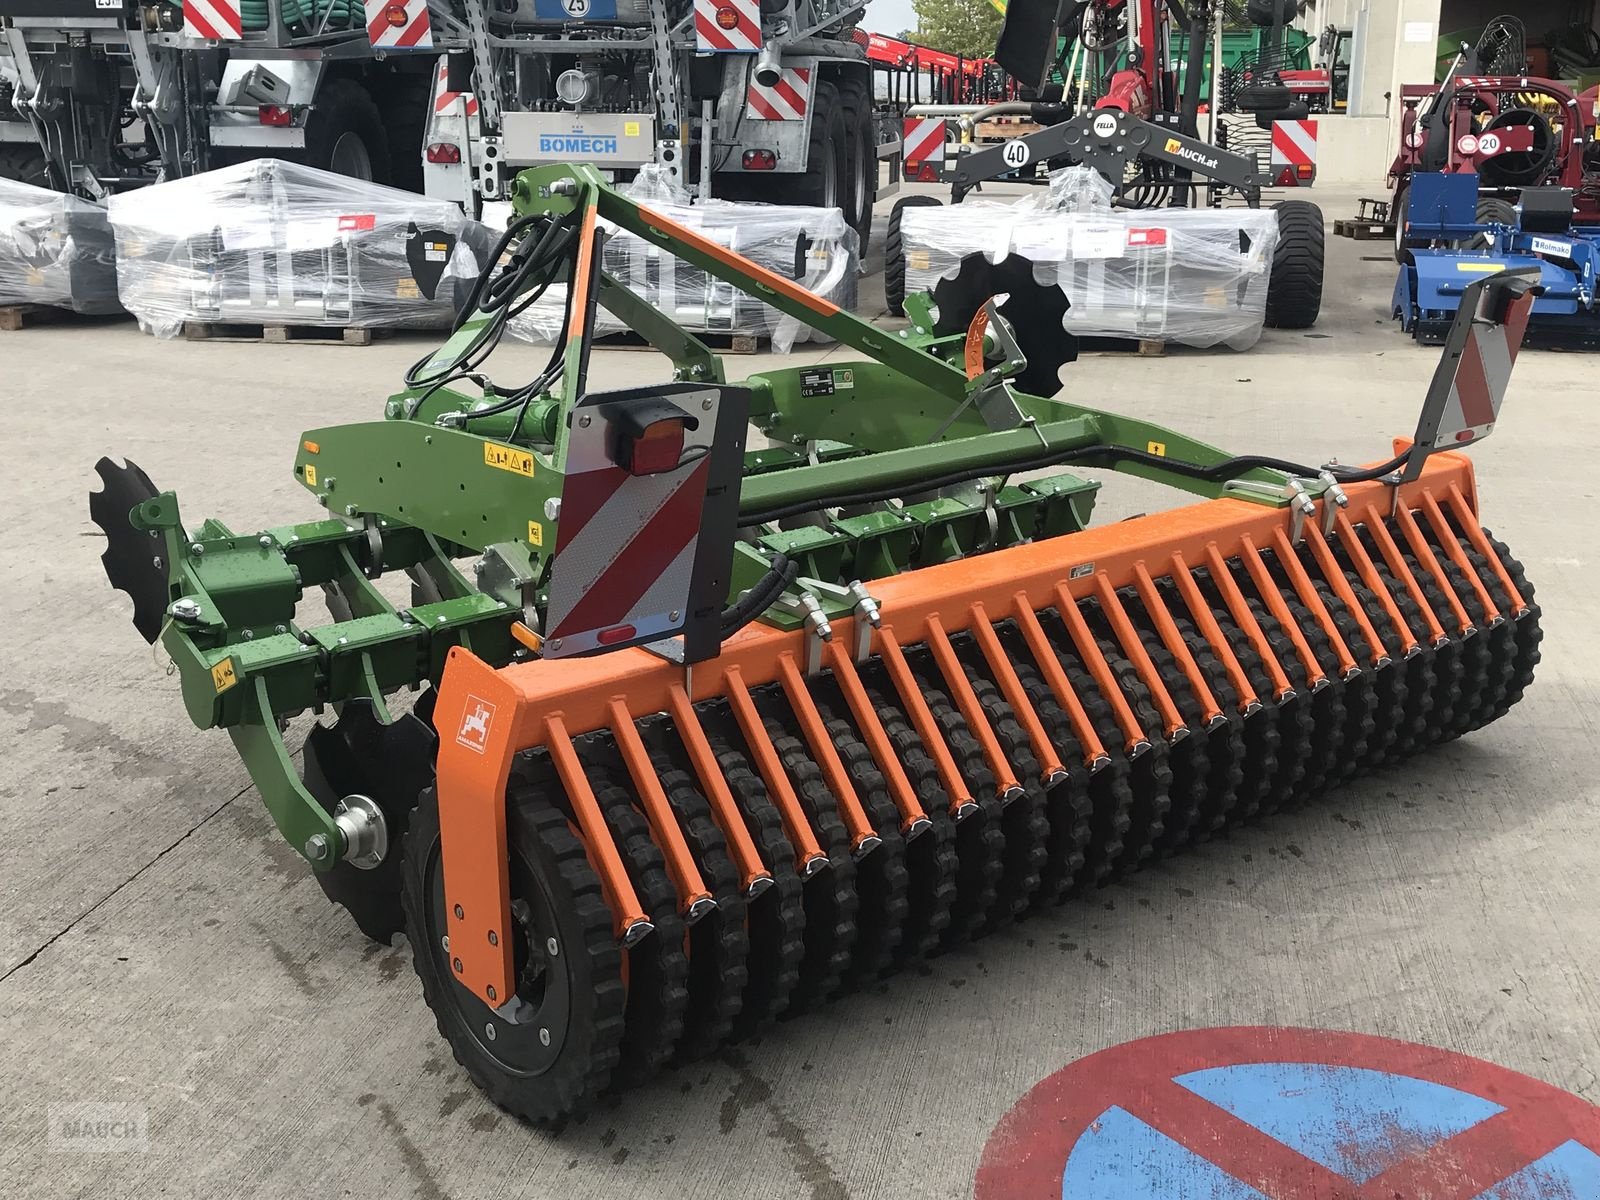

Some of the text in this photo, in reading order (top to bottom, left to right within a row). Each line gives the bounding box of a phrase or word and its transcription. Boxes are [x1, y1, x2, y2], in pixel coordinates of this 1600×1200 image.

[540, 138, 616, 153] BOMECH
[1481, 138, 1497, 150] 20
[1007, 145, 1025, 163] 40
[1168, 144, 1218, 169] MAUCH.at
[1540, 241, 1570, 255] Rolmako
